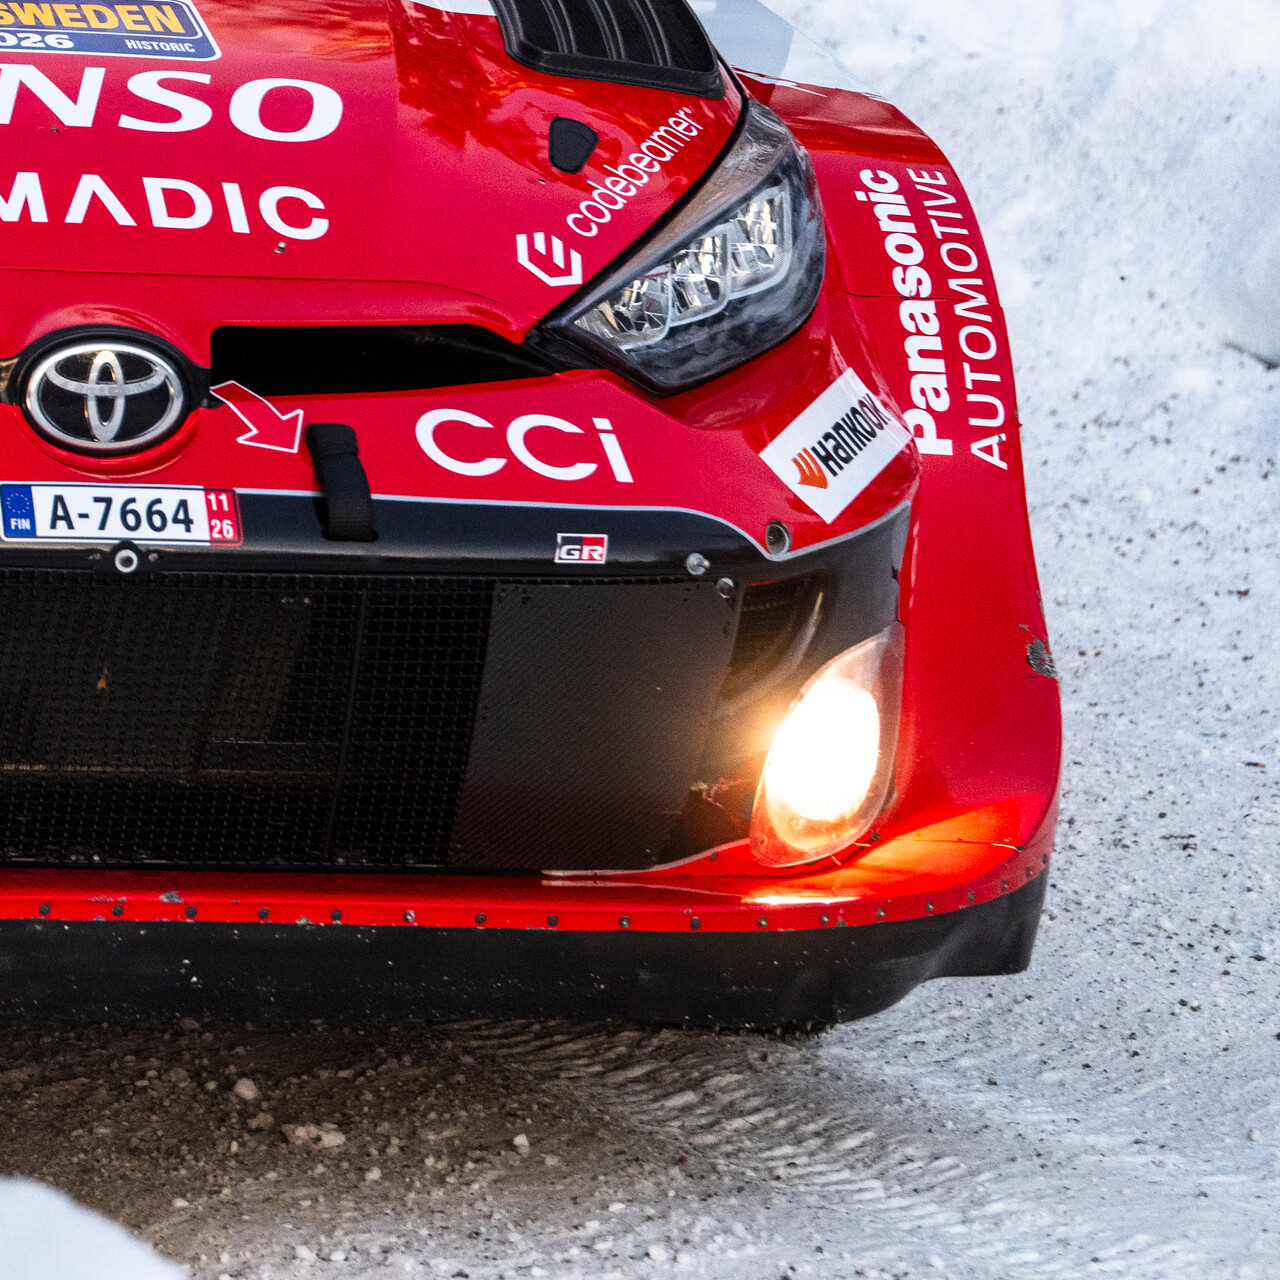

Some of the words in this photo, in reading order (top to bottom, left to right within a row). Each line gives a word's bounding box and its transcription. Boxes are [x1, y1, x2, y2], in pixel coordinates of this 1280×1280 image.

[125, 38, 196, 53] HISTORIC
[854, 168, 954, 456] Panasonic
[906, 167, 1009, 471] AUTOMOTIVE
[206, 492, 230, 512] 11
[48, 494, 195, 534] A-7664
[10, 518, 31, 531] FIN
[210, 518, 235, 539] 26
[558, 544, 604, 562] GR
